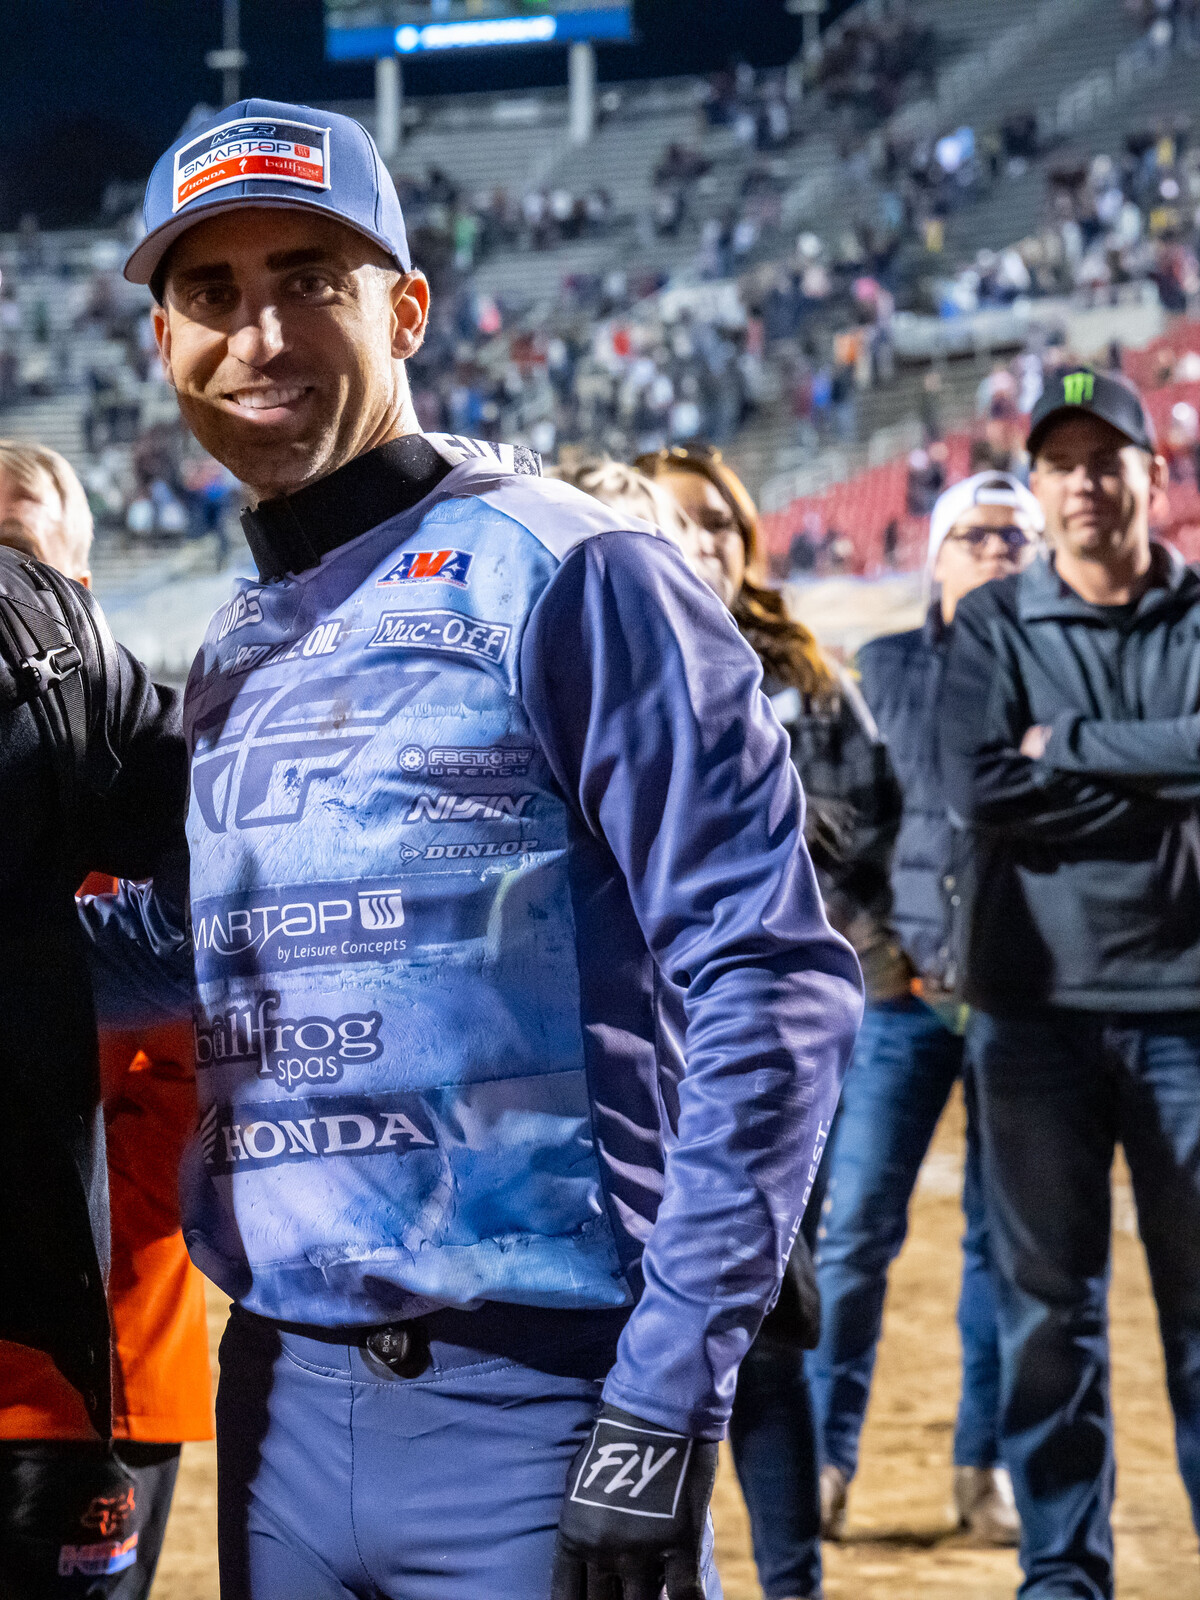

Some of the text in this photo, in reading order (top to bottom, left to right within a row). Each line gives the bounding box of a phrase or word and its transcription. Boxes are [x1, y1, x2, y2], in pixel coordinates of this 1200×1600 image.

[211, 126, 276, 145] MCR
[184, 141, 291, 178] SMARTOP
[189, 169, 226, 190] HONDA
[378, 550, 473, 584] AMA
[302, 622, 341, 657] OIL
[377, 619, 503, 656] Muc-Off
[423, 840, 539, 860] DUNLOP
[191, 900, 353, 956] MARTOP
[277, 938, 407, 963] by Leisure Concepts
[193, 998, 377, 1074] bullfrog
[277, 1055, 338, 1086] spas
[222, 1113, 435, 1162] HONDA
[382, 1334, 392, 1354] BOA
[582, 1442, 678, 1498] FLY
